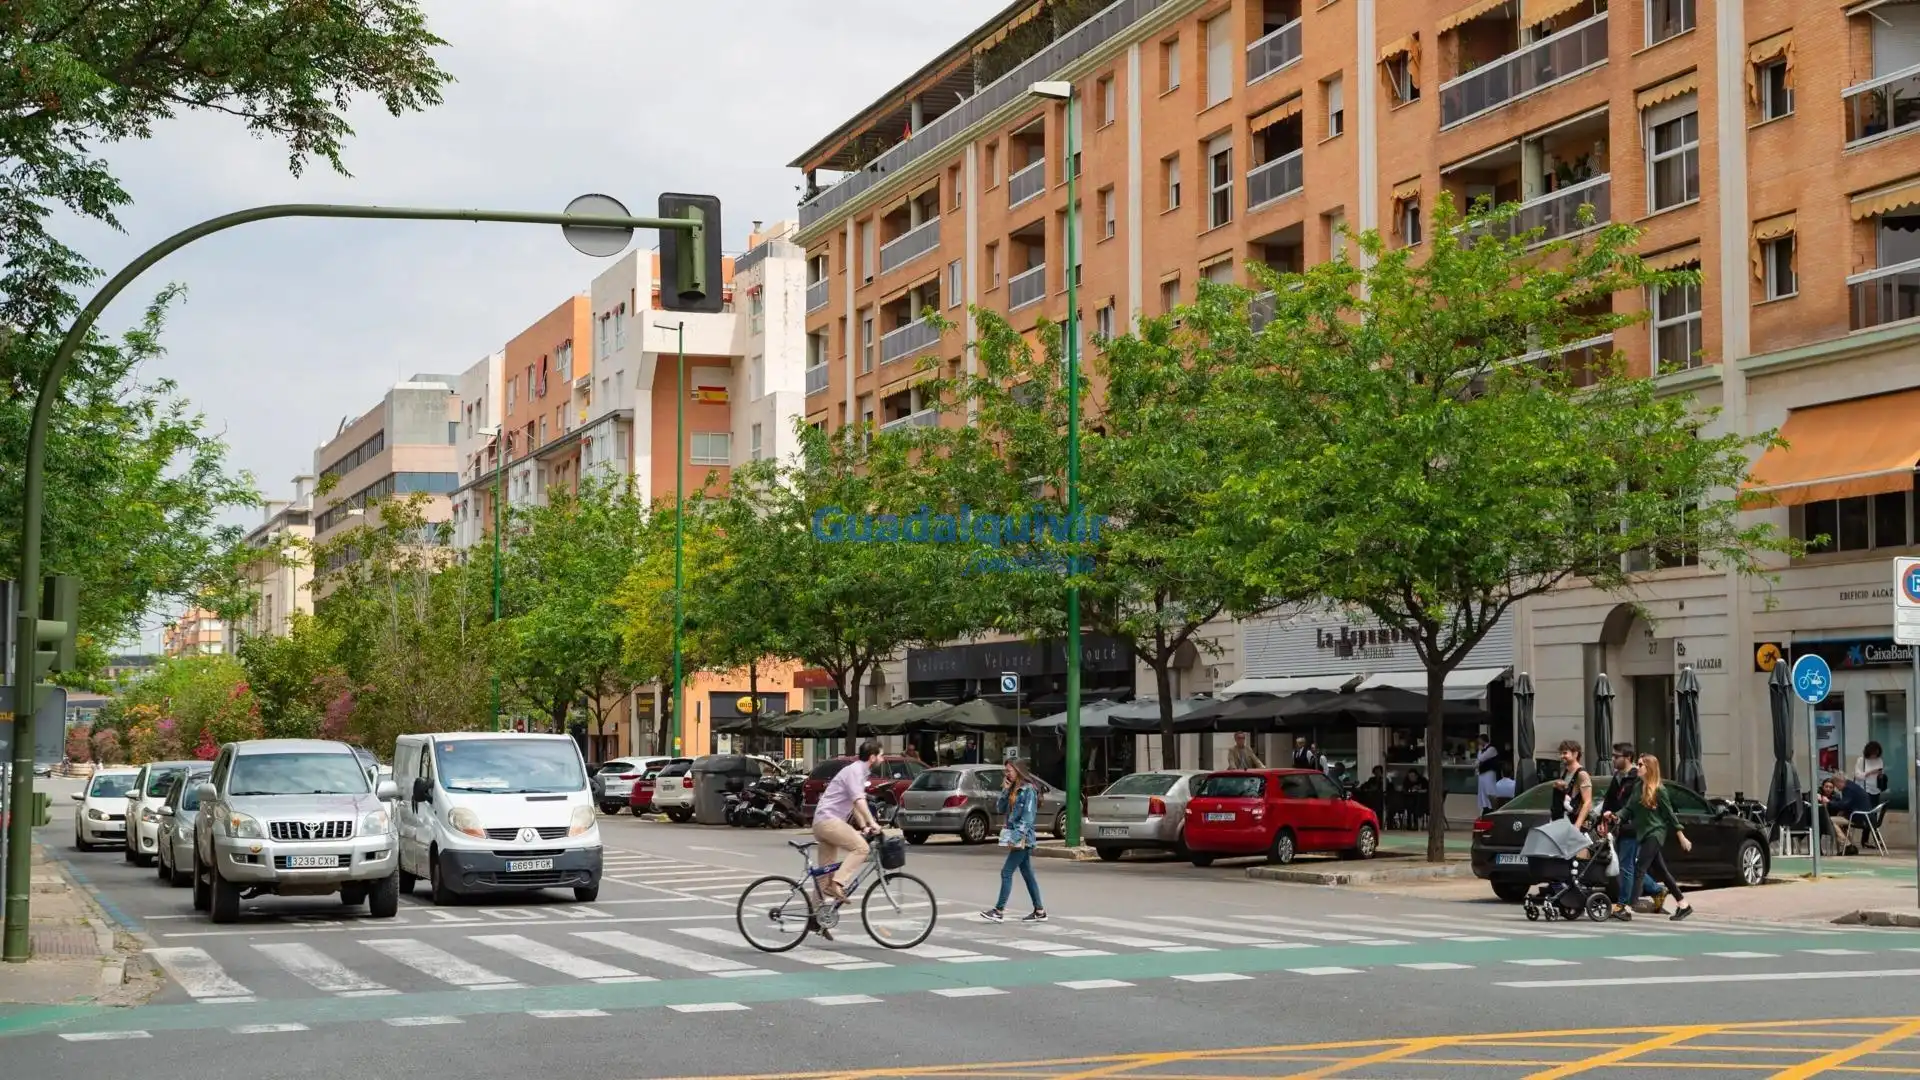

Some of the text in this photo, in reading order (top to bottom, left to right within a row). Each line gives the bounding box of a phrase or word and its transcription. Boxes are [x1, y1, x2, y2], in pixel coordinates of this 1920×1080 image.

[1840, 588, 1894, 600] EDIFICIO ALCAZ
[1648, 642, 1658, 655] 27
[1865, 644, 1913, 660] CaixaBank
[1696, 658, 1723, 669] ALCAZAR
[292, 855, 336, 866] 3239 CXH
